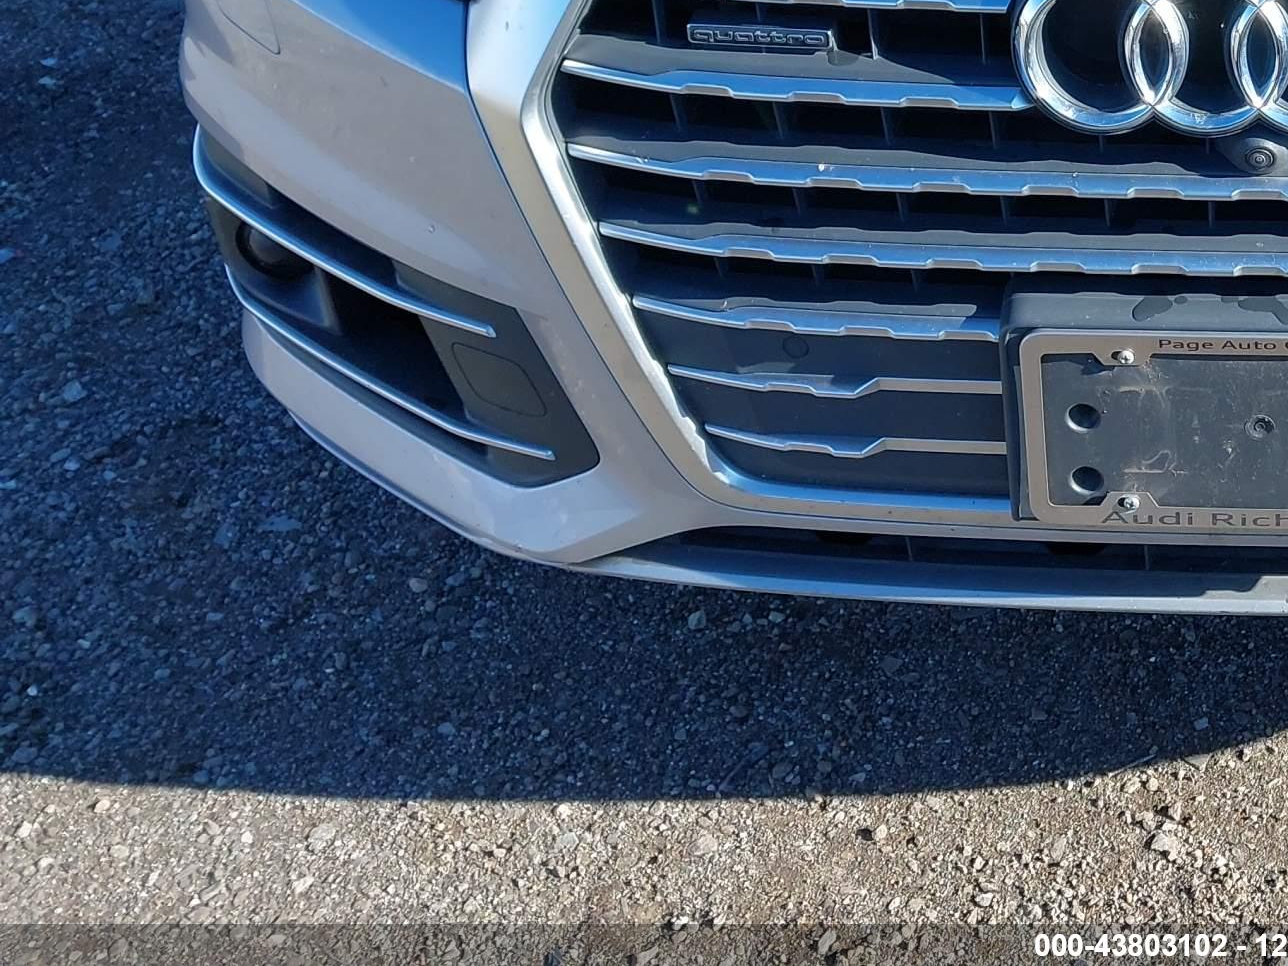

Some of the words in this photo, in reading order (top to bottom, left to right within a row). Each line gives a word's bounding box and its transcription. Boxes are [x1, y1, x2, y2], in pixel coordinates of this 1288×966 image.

[693, 29, 825, 45] quattro
[1158, 338, 1214, 352] Page
[1221, 339, 1276, 351] Auto
[1101, 510, 1194, 526] Audi
